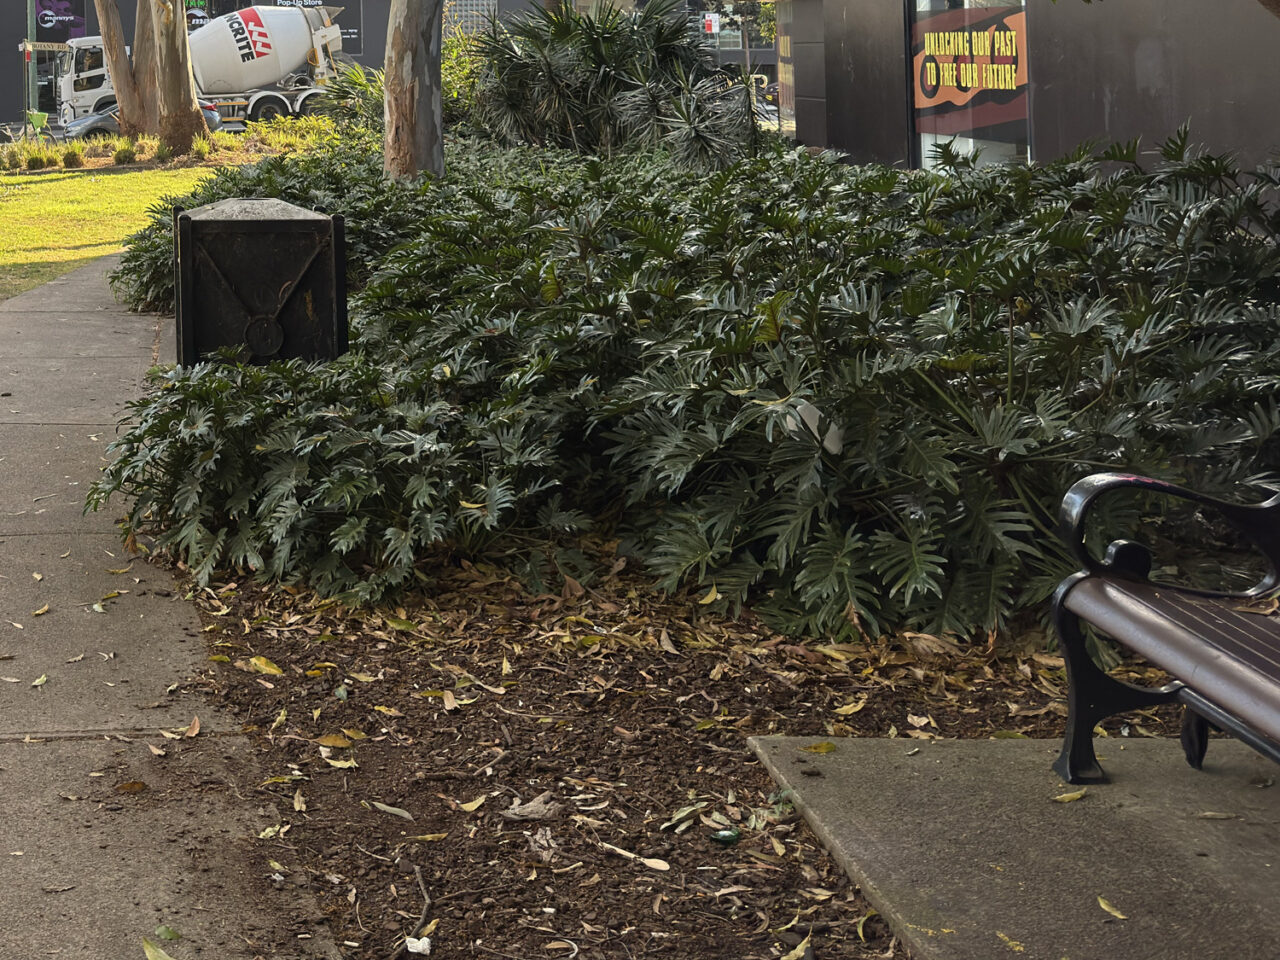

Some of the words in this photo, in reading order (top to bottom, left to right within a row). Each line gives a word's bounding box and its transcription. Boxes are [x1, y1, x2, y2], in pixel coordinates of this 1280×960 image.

[924, 32, 970, 56] UNLOCKING
[971, 31, 991, 56] OUR
[994, 30, 1017, 56] PAST
[926, 62, 937, 86] TO
[940, 62, 958, 87] FREE
[960, 63, 979, 88] OUR
[982, 63, 1017, 90] FUTURE
